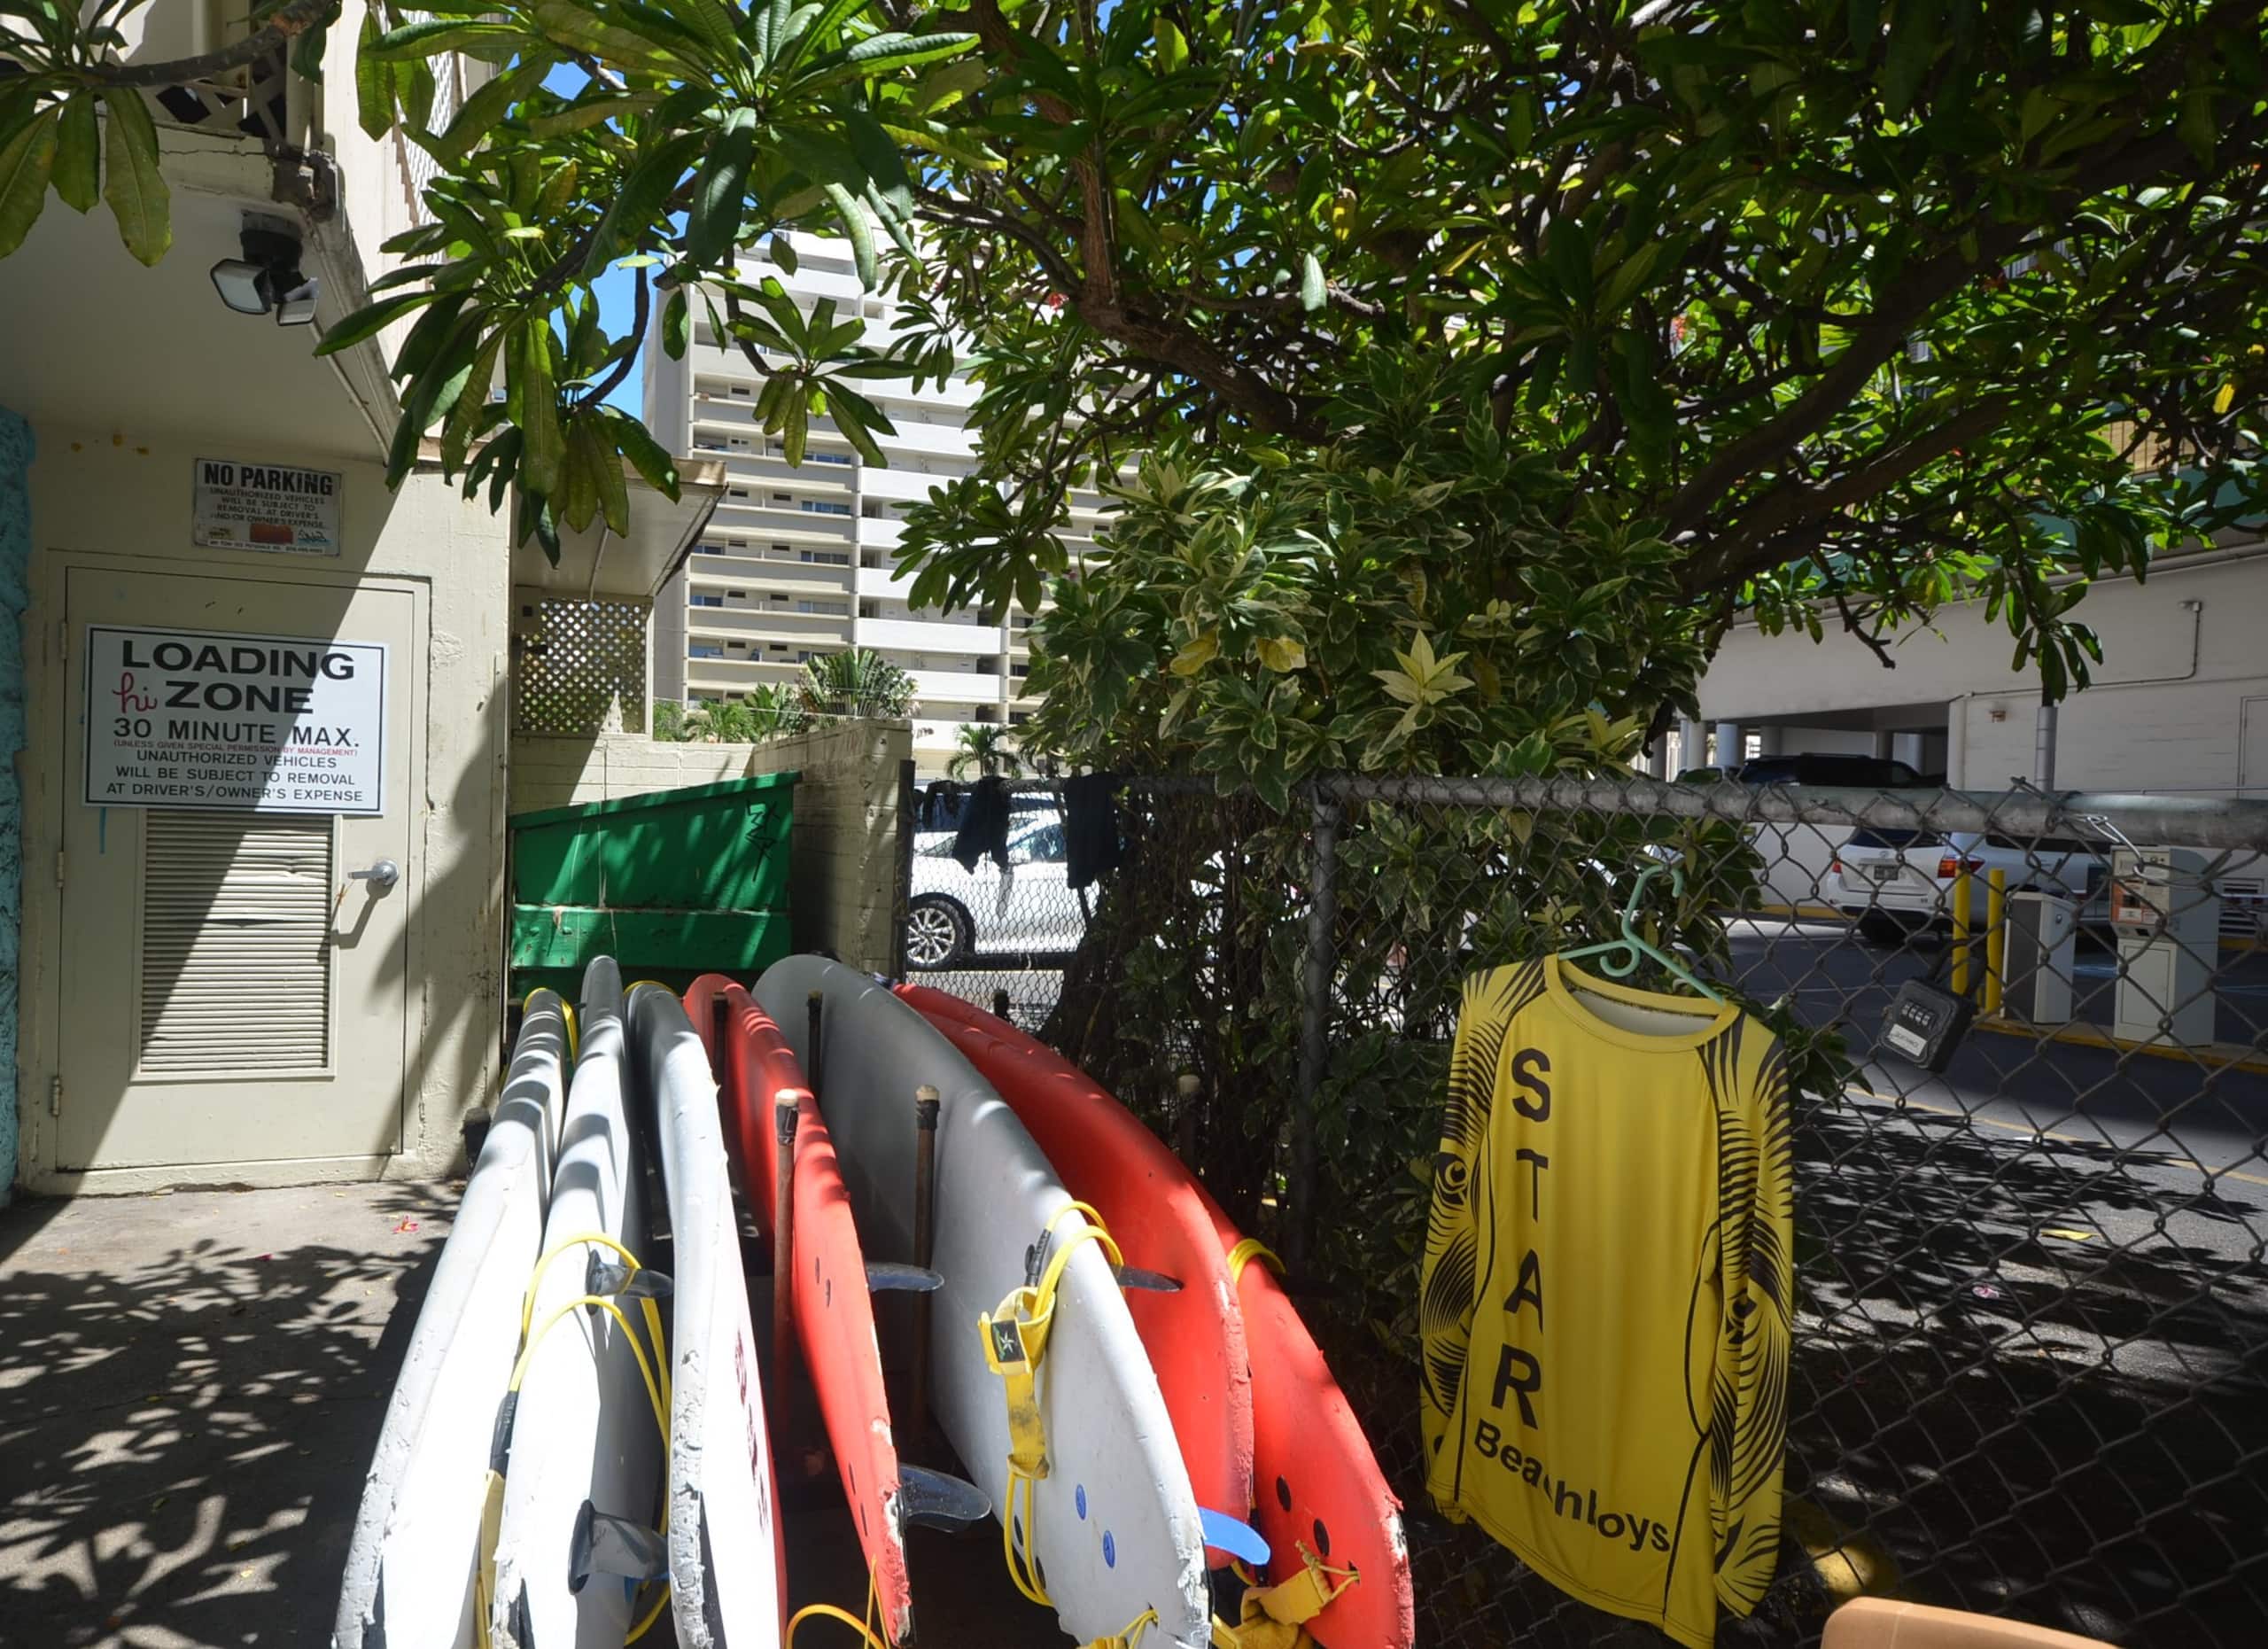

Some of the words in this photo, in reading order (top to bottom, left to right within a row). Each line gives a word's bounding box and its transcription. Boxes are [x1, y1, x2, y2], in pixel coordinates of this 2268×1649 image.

[205, 463, 234, 486] NO
[241, 466, 333, 496] PARKING
[210, 487, 281, 501] UNAUTHORIZED
[284, 494, 325, 504] VEHICLES
[262, 501, 299, 510] SUBJECT
[216, 504, 264, 515] REMOVAL
[122, 640, 354, 681] LOADING
[112, 672, 158, 713] hi
[165, 681, 314, 714] ZONE
[113, 718, 151, 738] 30
[168, 719, 276, 743] MINUTE
[292, 726, 360, 748] MAX.
[113, 739, 154, 749] (UNLESS
[157, 741, 184, 751] GIVEN
[188, 742, 223, 751] SPECIAL
[227, 743, 281, 754] PERMISSION
[136, 750, 257, 766] UNAUTHORIZED
[264, 755, 338, 769] VEHICLES
[115, 765, 151, 778] WILL
[158, 766, 178, 779] BE
[187, 768, 254, 782] SUBJECT
[261, 771, 280, 783] TO
[287, 773, 355, 786] REMOVAL
[106, 782, 126, 795] AT
[133, 783, 286, 799] DRIVER'S/OWNER'S
[293, 789, 363, 802] EXPENSE
[1490, 1047, 1551, 1430] STAR
